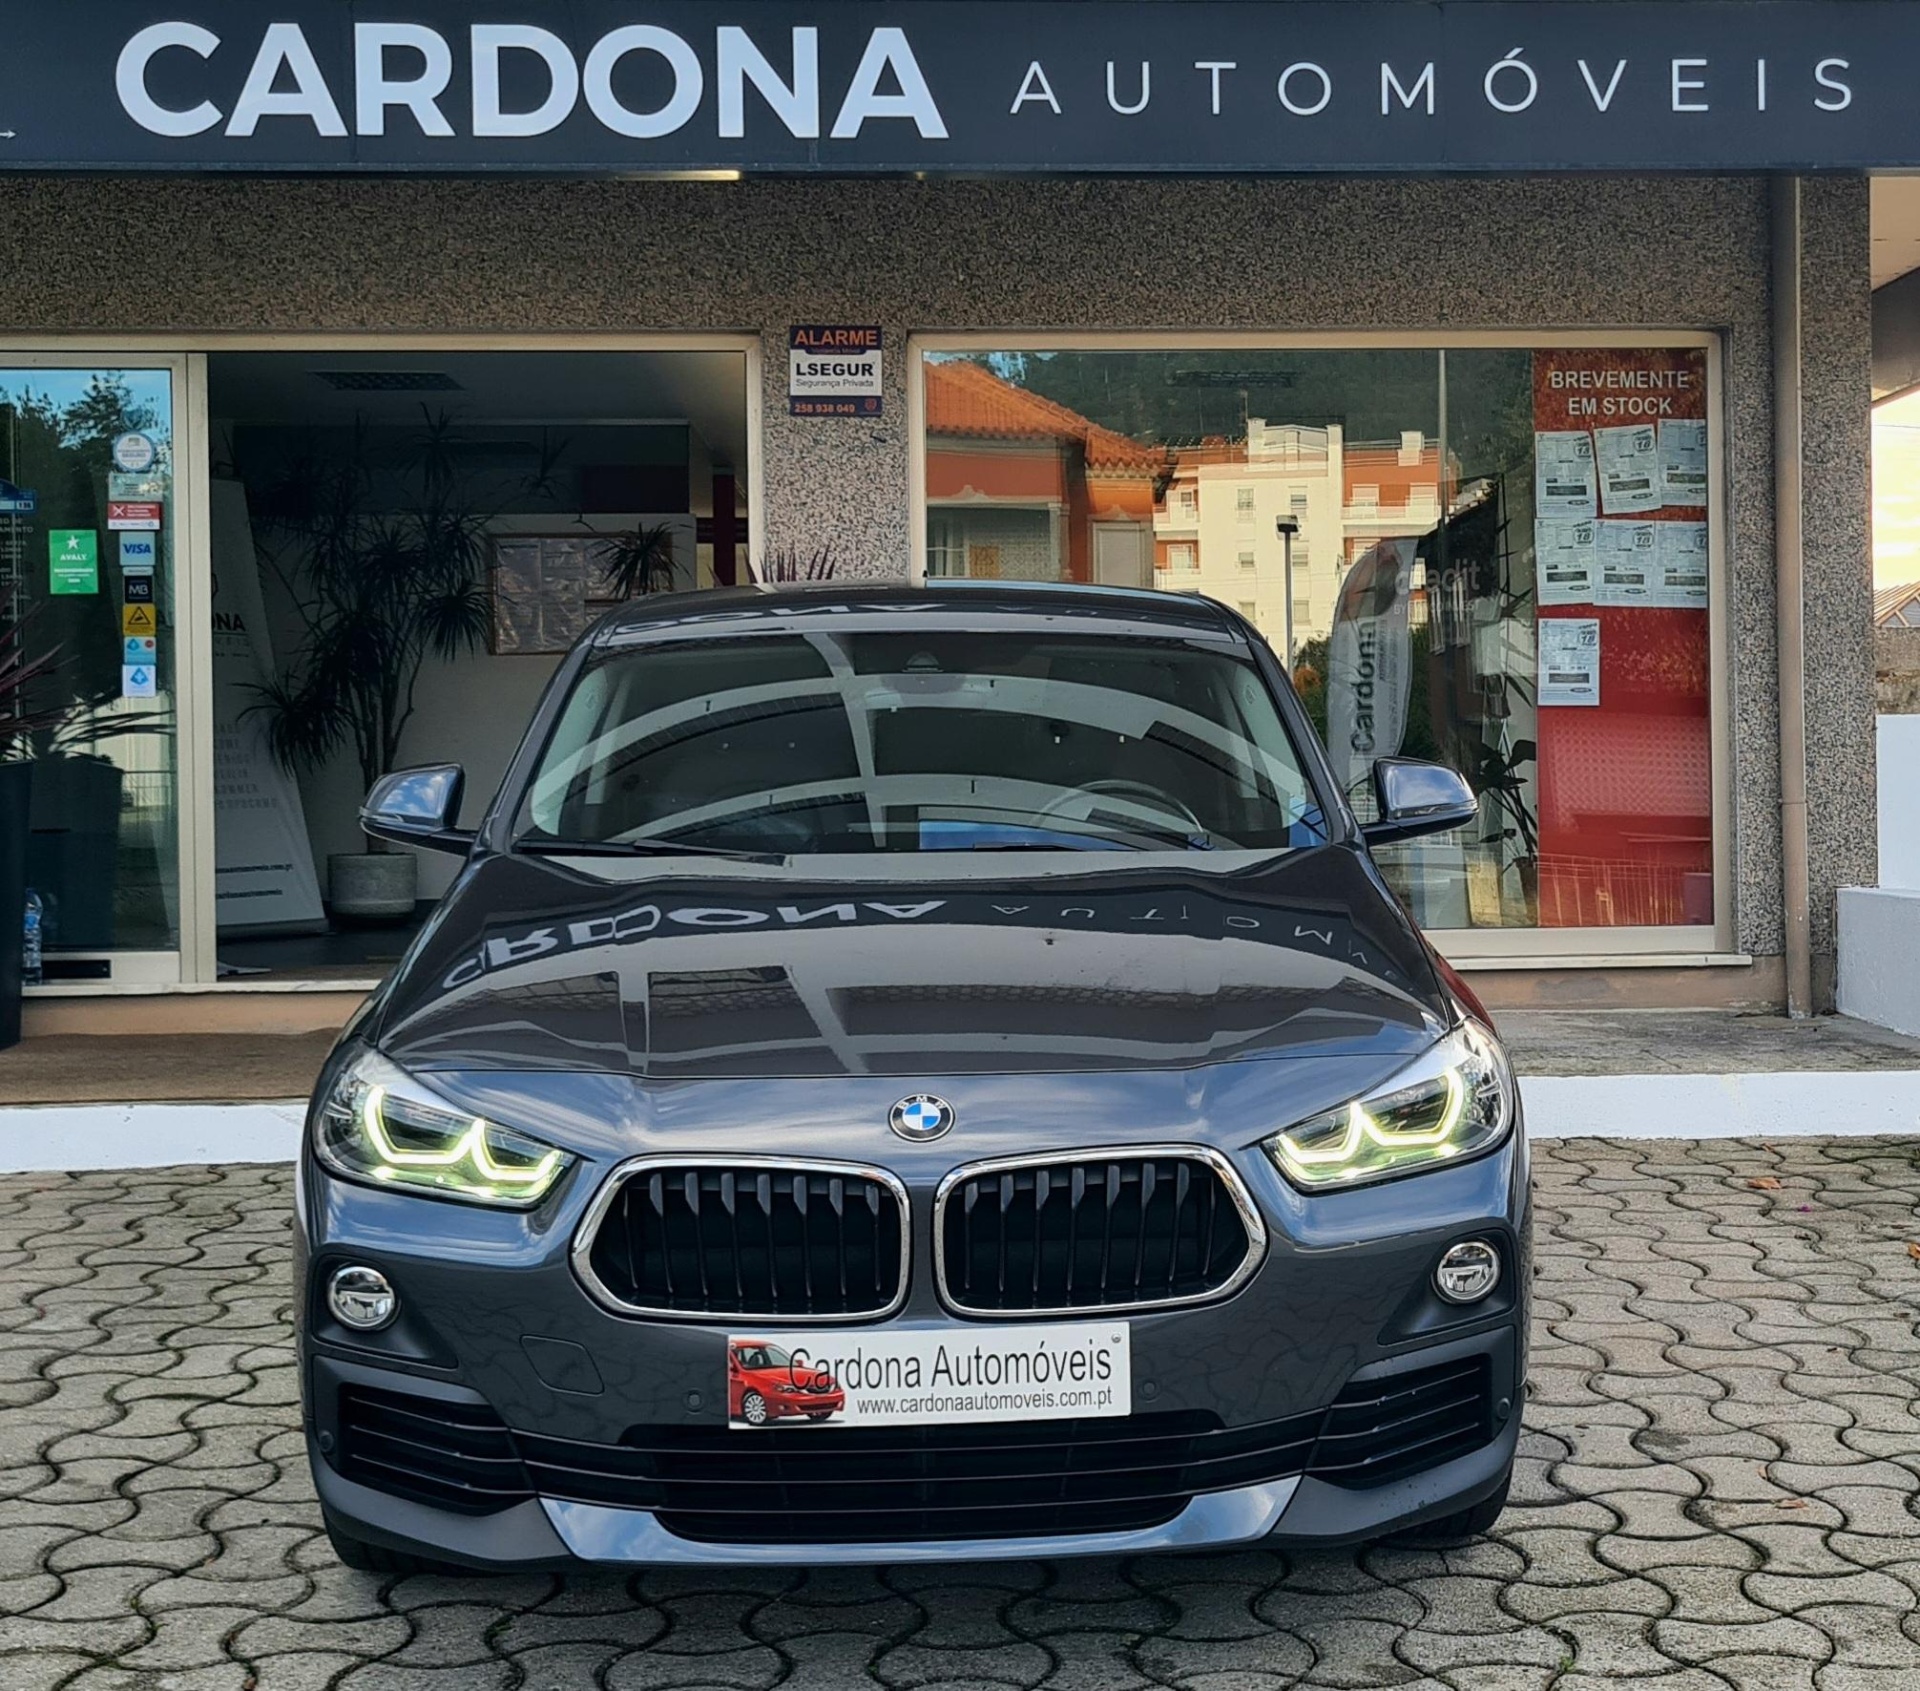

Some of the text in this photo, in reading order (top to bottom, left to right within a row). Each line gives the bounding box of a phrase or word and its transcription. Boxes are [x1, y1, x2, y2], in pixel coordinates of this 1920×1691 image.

[116, 21, 1853, 139] CARDONA AUTOMÓVEIS
[794, 330, 877, 346] ALARME
[796, 363, 874, 376] LSEGUR
[796, 379, 874, 388] Segurança Privada
[1551, 371, 1690, 389] BREVEMENTE
[1568, 397, 1672, 415] EM STOCK
[123, 544, 151, 554] VISA
[128, 584, 149, 595] MB
[789, 1339, 1112, 1391] Cardona Automóveis
[857, 1387, 1113, 1415] www.cardonaautomoveis.com.pt
